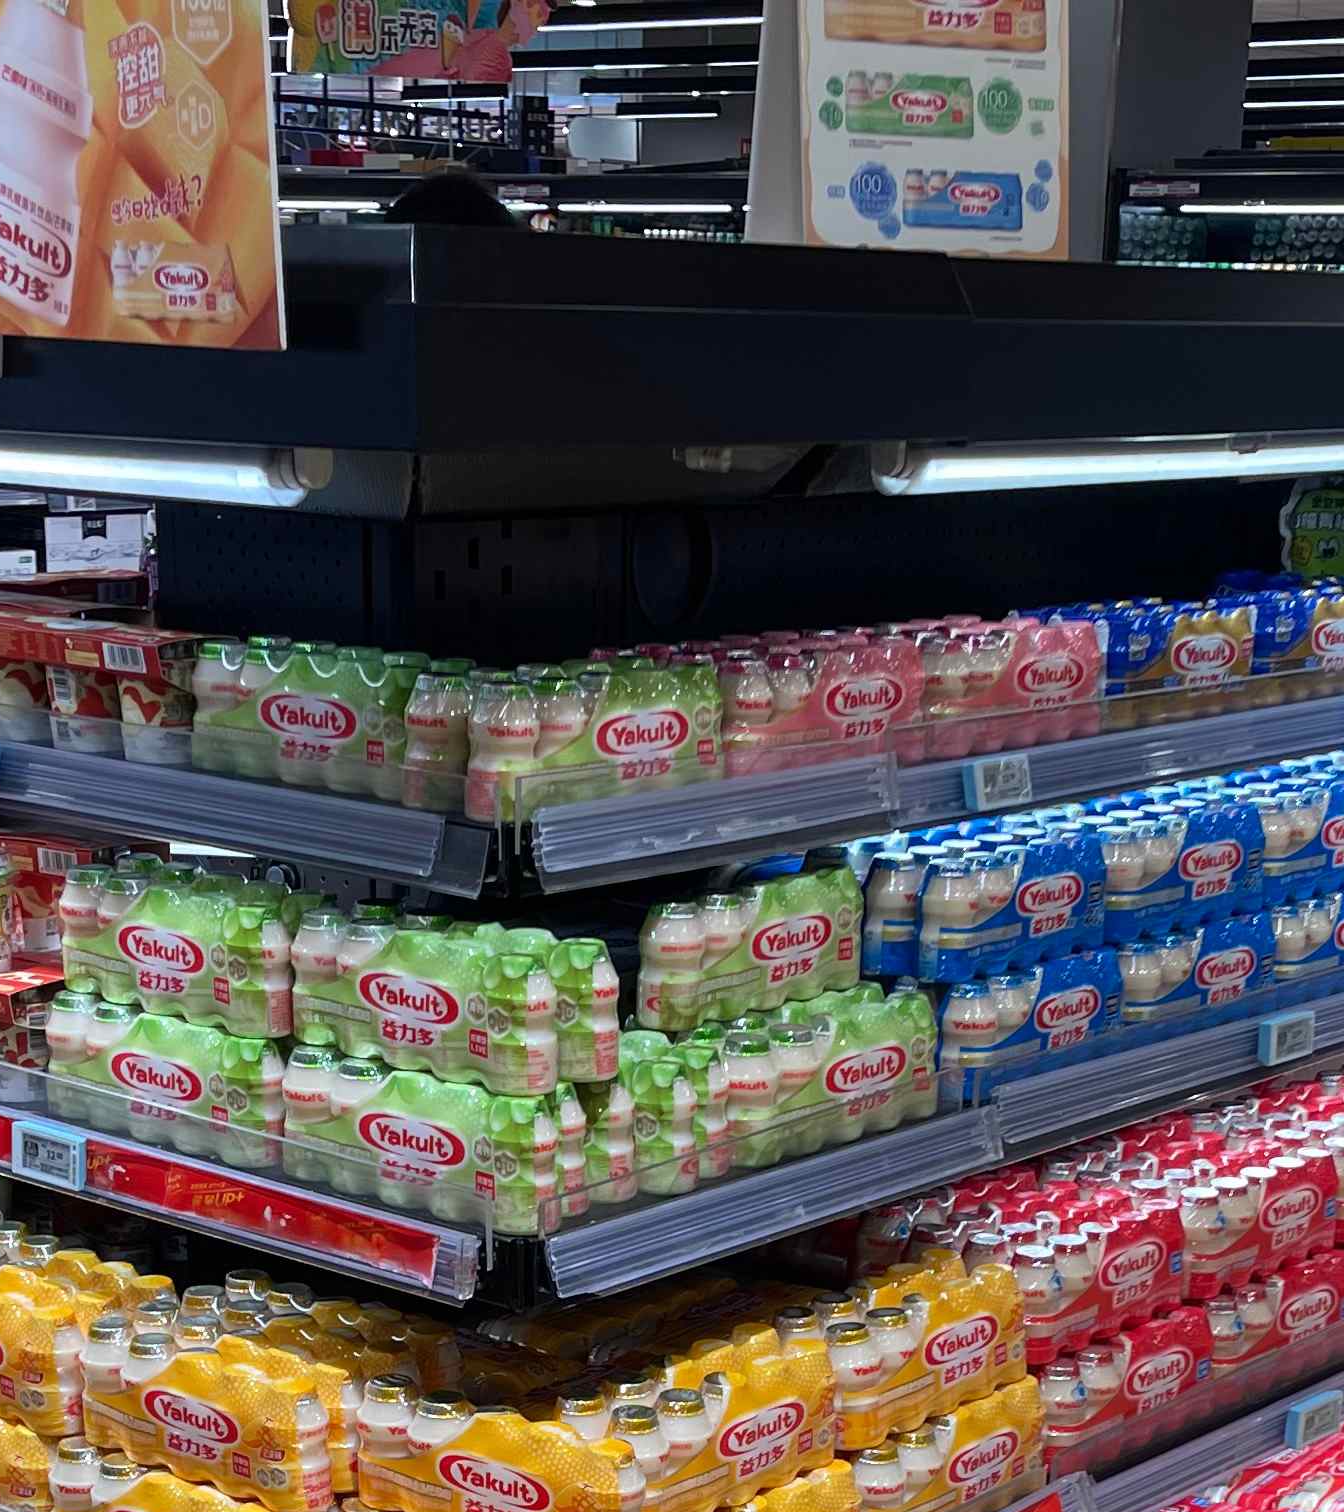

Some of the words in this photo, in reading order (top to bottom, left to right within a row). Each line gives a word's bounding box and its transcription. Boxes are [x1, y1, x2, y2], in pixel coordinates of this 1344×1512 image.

[855, 174, 881, 194] 100
[163, 272, 202, 286] Yakult
[1181, 642, 1233, 666] Yakult
[1024, 659, 1077, 689] Yakult
[832, 681, 895, 713] Yakult
[272, 702, 344, 734] Yakult
[844, 717, 886, 738] 益力多
[611, 720, 680, 746] Yakult
[279, 738, 335, 764] 益力多
[619, 758, 672, 781] 益力多
[1187, 849, 1236, 874] Yakult
[1024, 882, 1077, 908] Yakult
[129, 934, 192, 967] Yakult
[766, 922, 821, 952] Yakult
[138, 970, 185, 994] 益力多
[768, 958, 813, 983] 益力多
[1200, 956, 1251, 981] Yakult
[371, 982, 444, 1015] Yakult
[1044, 994, 1096, 1019] Yakult
[381, 1020, 435, 1046] 益力多
[123, 1059, 190, 1094] Yakult
[838, 1052, 897, 1083] Yakult
[374, 1122, 450, 1160] Yakult
[1265, 1196, 1315, 1223] Yakult
[1105, 1255, 1160, 1281] Yakult
[1286, 1297, 1330, 1324] Yakult
[936, 1319, 993, 1356] Yakult
[943, 1355, 985, 1384] 益力多
[1133, 1360, 1186, 1390] Yakult
[156, 1399, 225, 1436] Yakult
[732, 1407, 792, 1452] Yakult
[166, 1434, 219, 1461] 益力多
[738, 1447, 786, 1475] 益力多
[961, 1438, 1010, 1471] Yakult
[454, 1458, 534, 1503] Yakult
